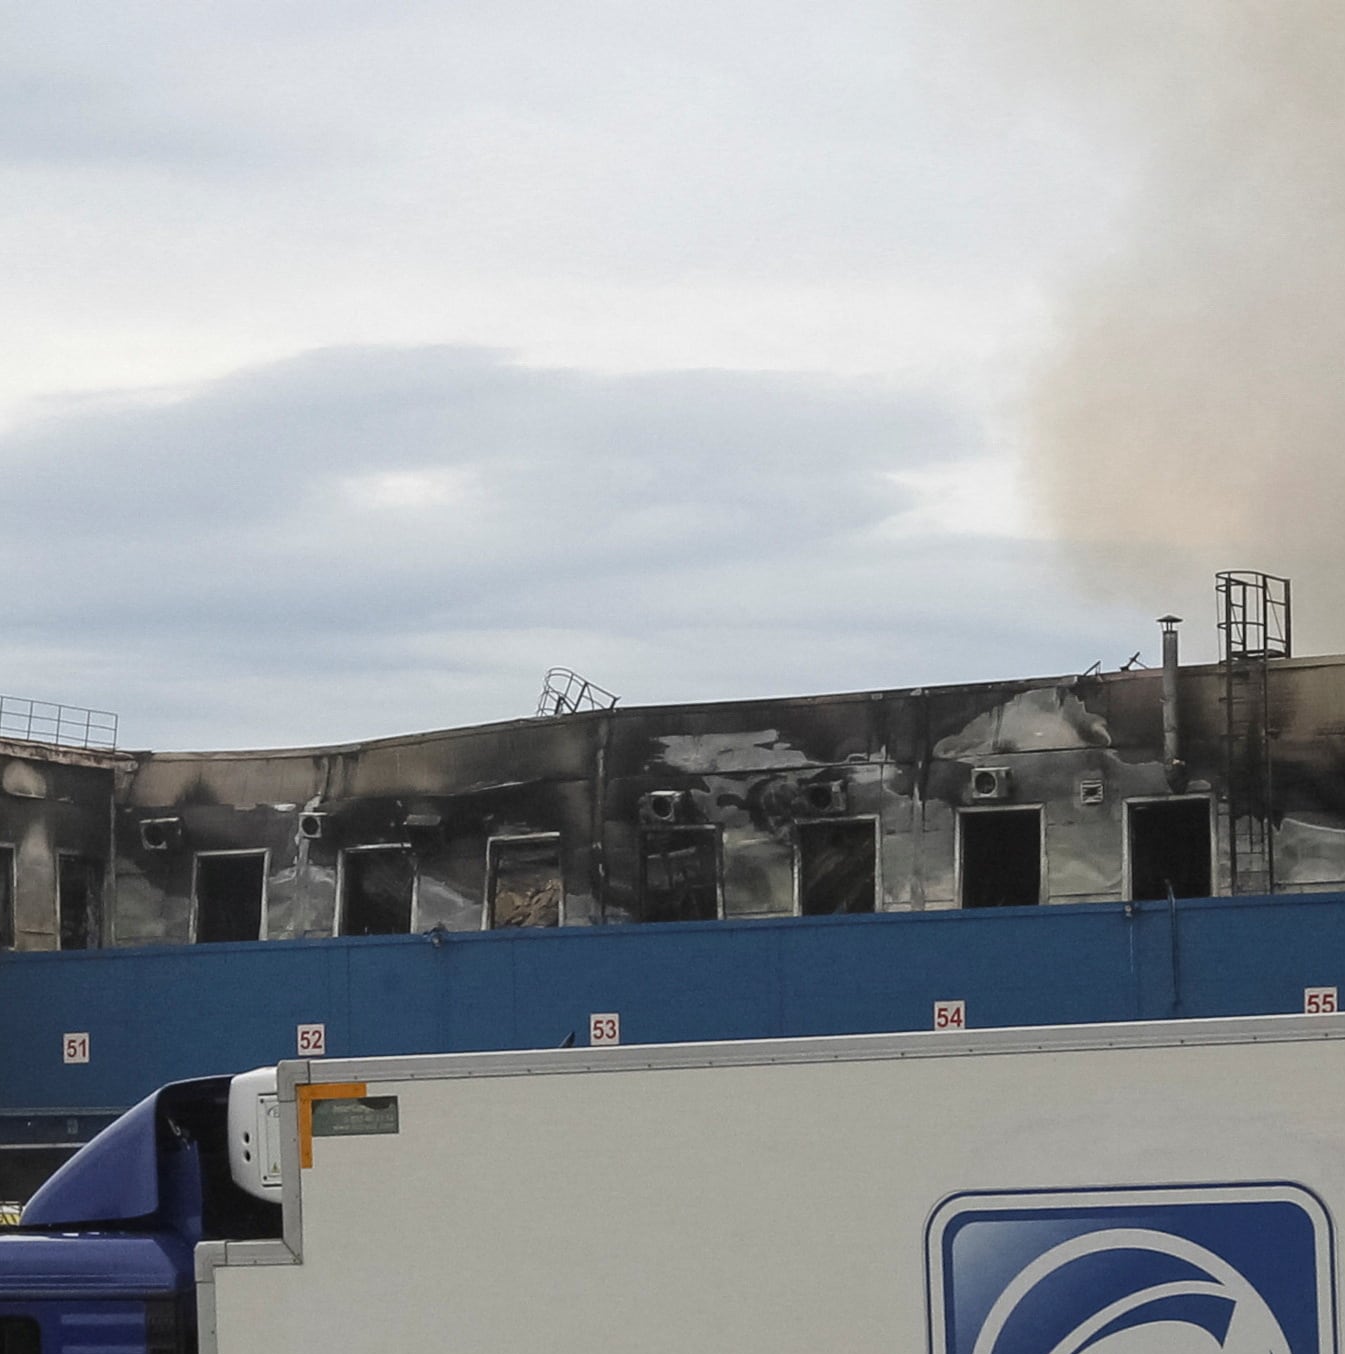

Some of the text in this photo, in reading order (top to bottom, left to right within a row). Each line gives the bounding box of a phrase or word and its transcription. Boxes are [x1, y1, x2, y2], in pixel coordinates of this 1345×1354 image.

[1307, 994, 1335, 1014] 55
[937, 1007, 962, 1028] 54
[300, 1030, 322, 1049] 52
[593, 1020, 616, 1040] 53
[67, 1039, 86, 1058] 51
